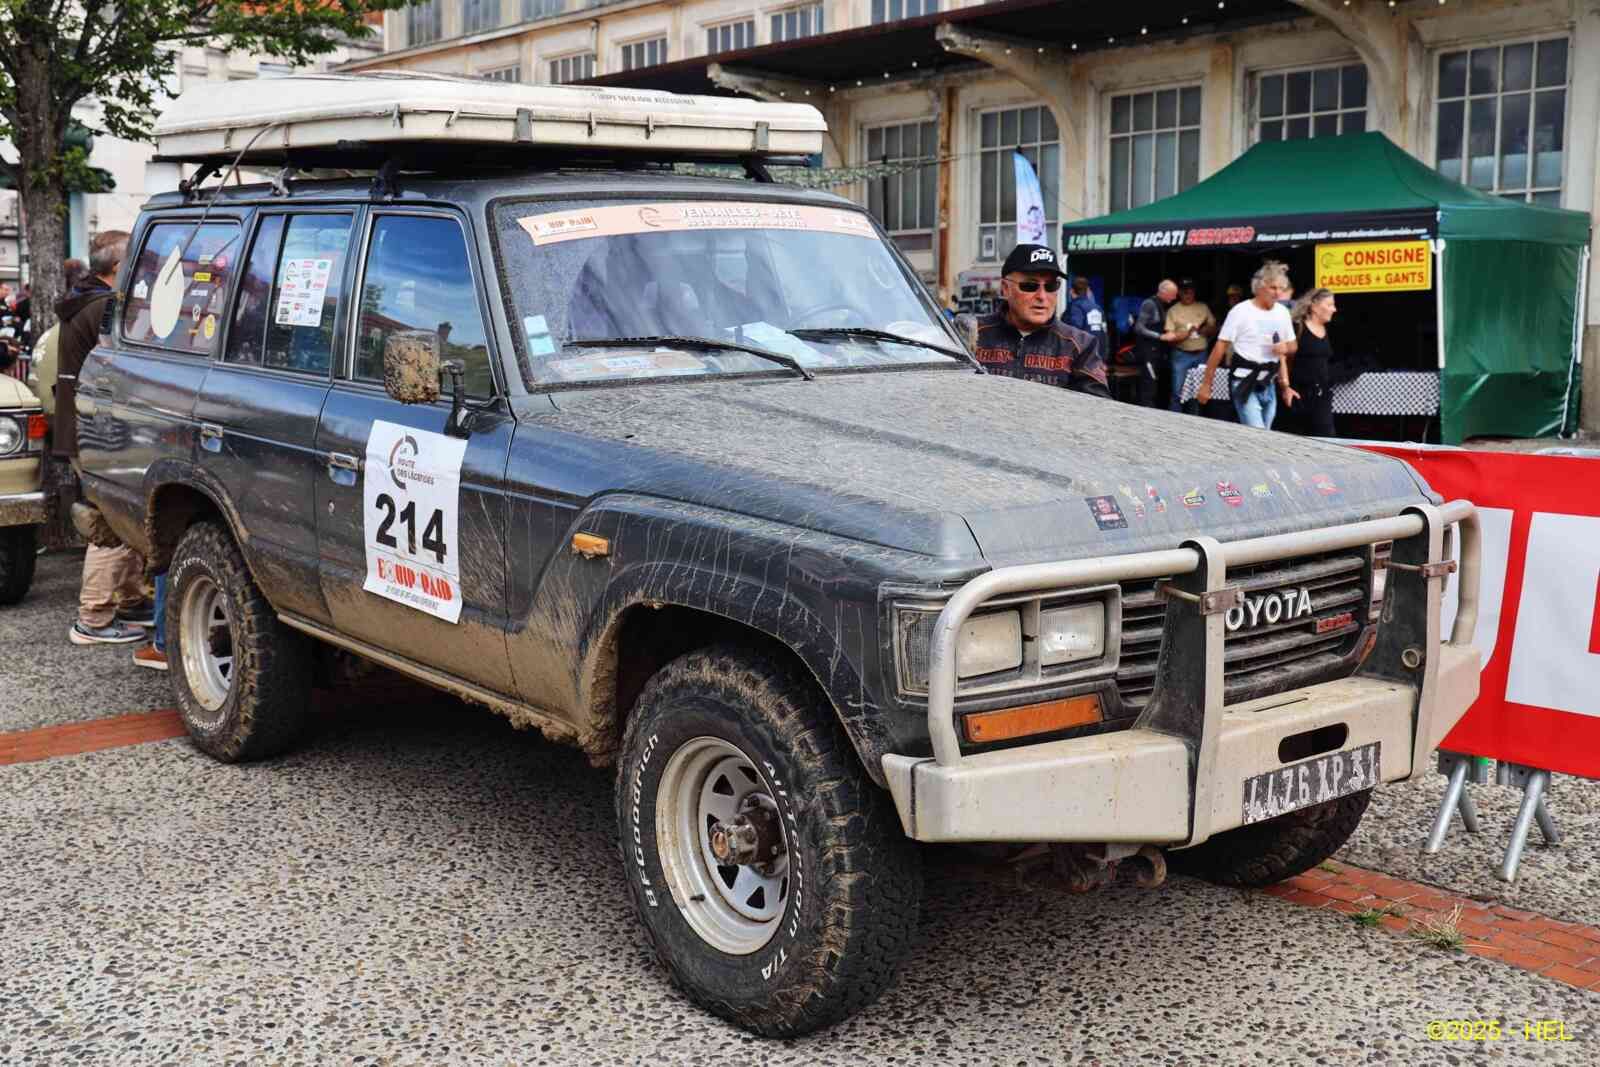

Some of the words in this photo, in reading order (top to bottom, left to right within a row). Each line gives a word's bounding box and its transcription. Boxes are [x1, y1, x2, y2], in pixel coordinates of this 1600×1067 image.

[1133, 229, 1186, 248] DUCATI
[1343, 247, 1425, 267] CONSIGNE
[1320, 273, 1373, 288] CASQUES
[1384, 271, 1425, 285] GANTS
[375, 493, 447, 564] 214
[1225, 589, 1313, 631] OYOTA
